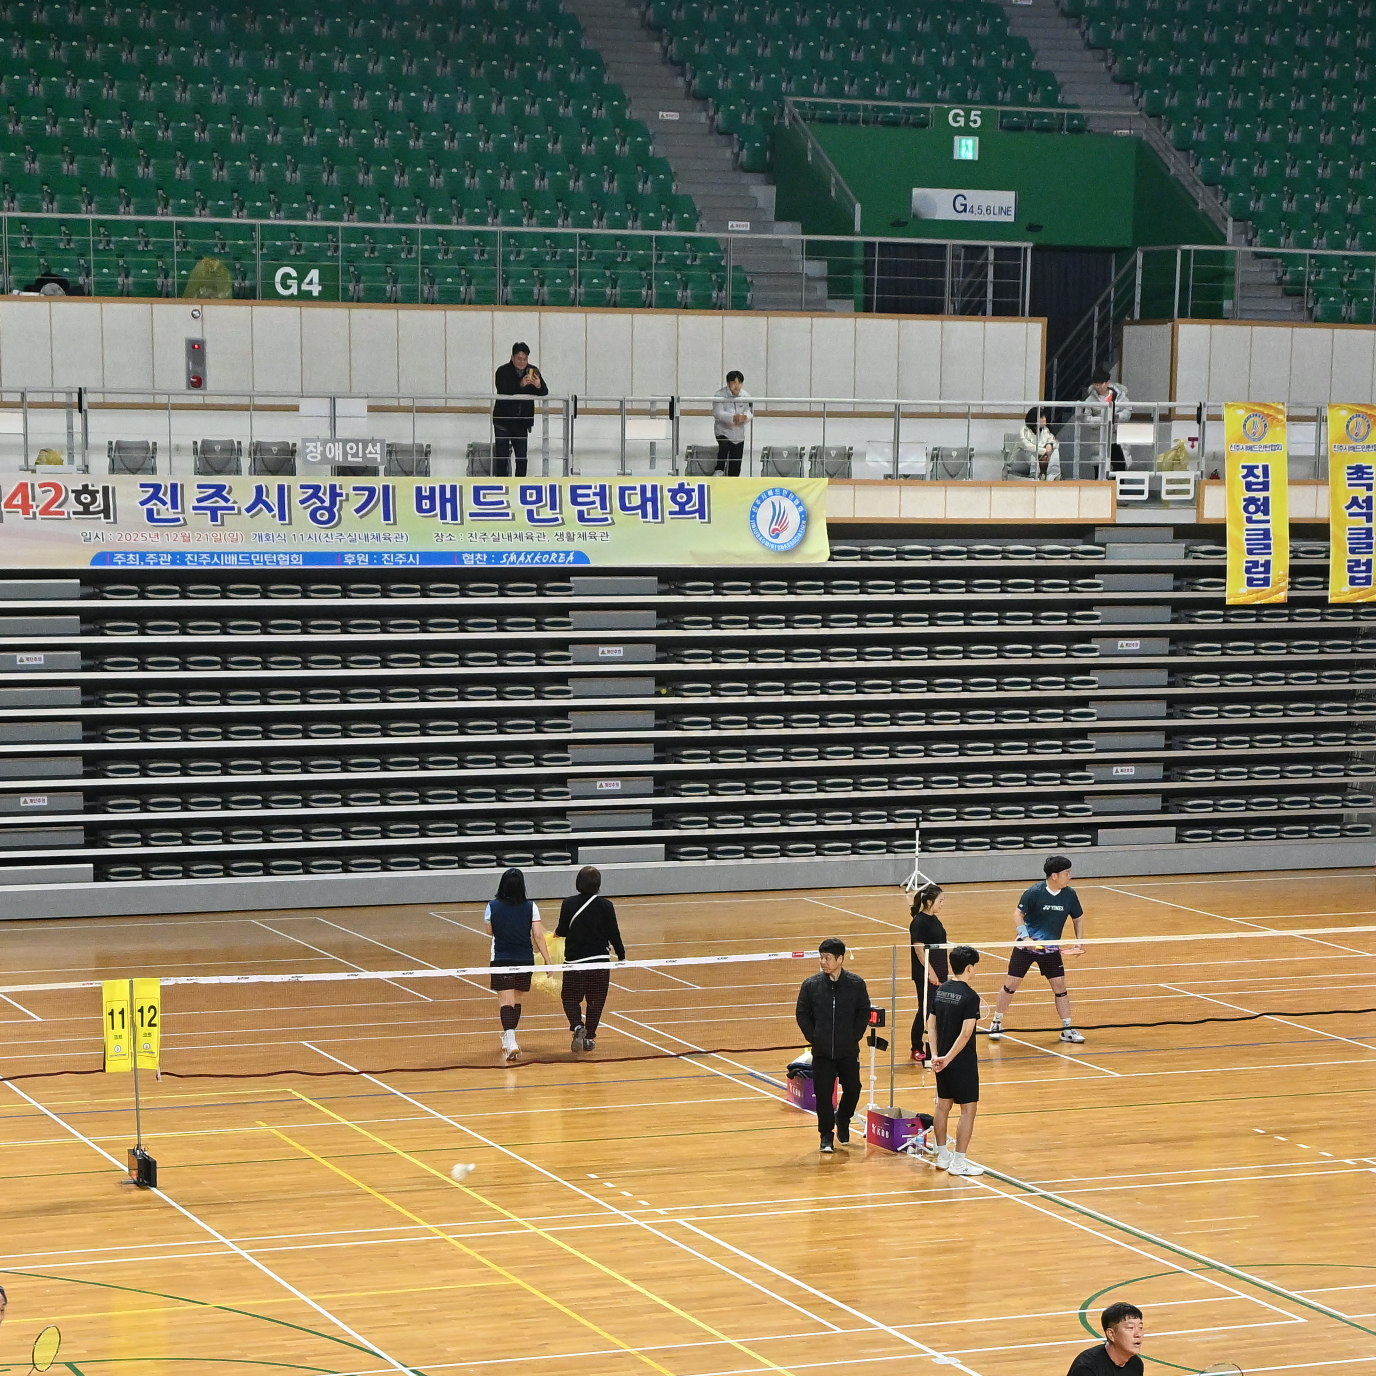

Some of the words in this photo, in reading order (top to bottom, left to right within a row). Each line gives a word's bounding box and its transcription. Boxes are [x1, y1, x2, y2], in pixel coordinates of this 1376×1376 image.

[948, 108, 982, 128] G5
[274, 266, 322, 297] G4
[305, 441, 381, 462] 장애인석
[138, 482, 397, 527] 진주시장기
[414, 481, 709, 526] 배드민턴대회
[1240, 463, 1273, 588] 집현클럽
[1344, 464, 1375, 588] 촉석클럽
[80, 531, 105, 543] 일시
[116, 531, 160, 543] 2025년
[165, 531, 192, 543] 12월
[196, 531, 245, 544] 21일(일)
[251, 531, 288, 543] 개회식
[291, 531, 410, 545] 11시(진주실내체육관)
[433, 532, 456, 542] 장소
[554, 531, 610, 542] 생활체육관
[113, 553, 172, 566] 주최,주관
[185, 553, 303, 566] 진주시배드민턴협회
[343, 553, 369, 565] 후원
[381, 553, 420, 565] 진주시
[462, 552, 487, 565] 협찬
[107, 1008, 125, 1030] 11
[137, 1005, 157, 1027] 12
[876, 1128, 889, 1139] KBB
